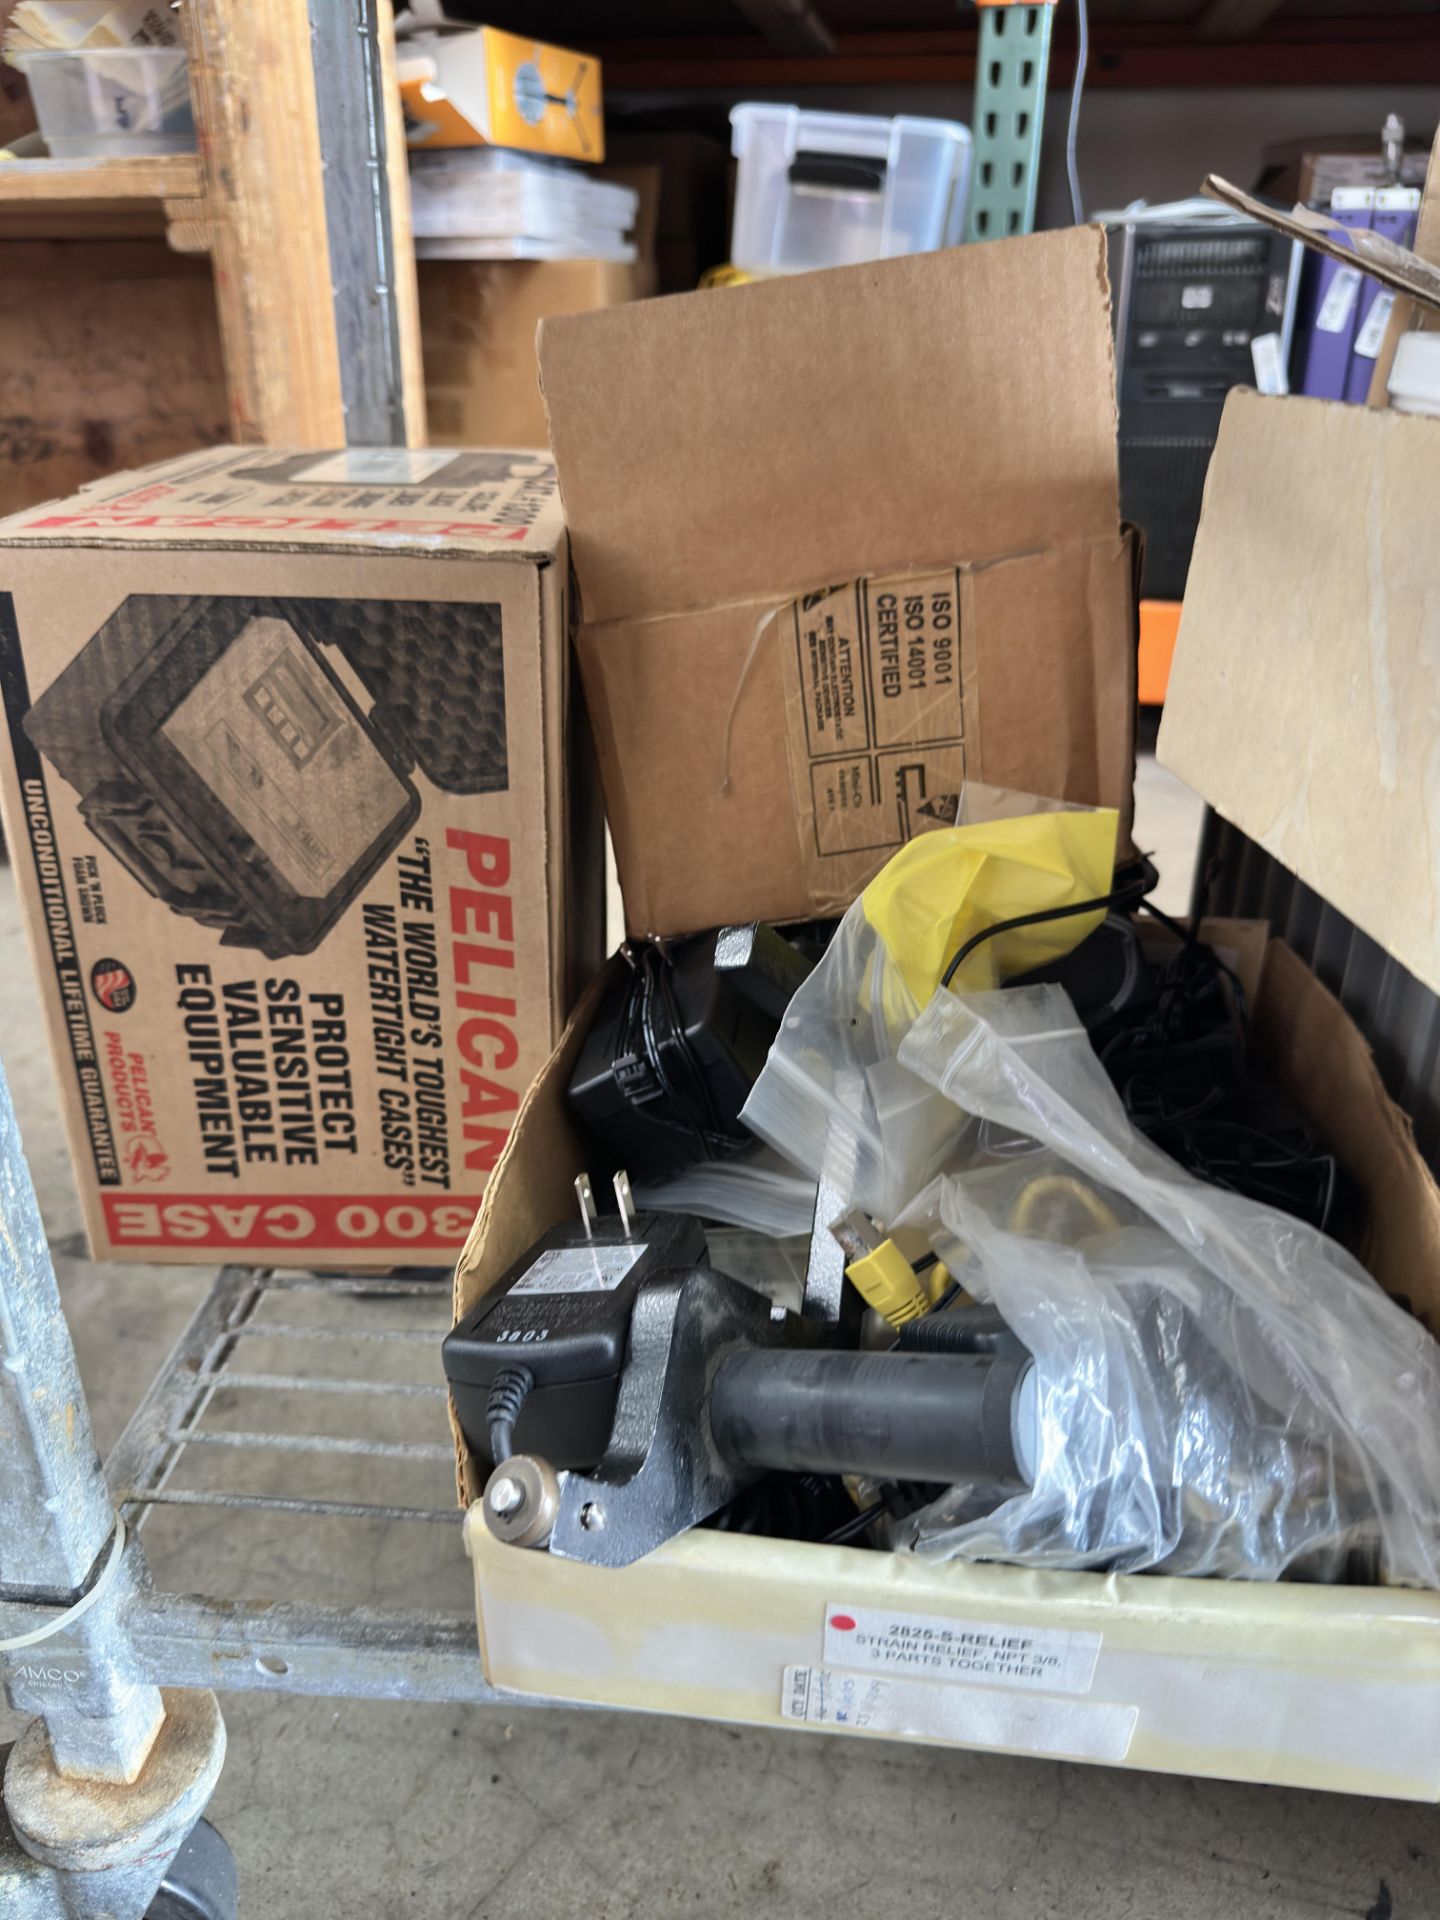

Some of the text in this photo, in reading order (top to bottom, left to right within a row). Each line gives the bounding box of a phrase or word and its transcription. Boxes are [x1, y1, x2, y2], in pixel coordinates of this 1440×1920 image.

[838, 638, 855, 717] ATTENTION
[876, 593, 902, 699] CERTIFIED
[904, 595, 927, 690] ISO 14001
[931, 591, 953, 686] ISO 9001
[23, 778, 118, 1181] UNCONDITIONAL LIFETIME GUARANTEE
[362, 903, 408, 1083] WATERTIGHT
[402, 922, 443, 1050] WORLD'S
[446, 827, 521, 1173] PELICAN
[104, 1030, 137, 1134] PRODUCTS
[175, 963, 240, 1178] EQUIPMENT
[222, 980, 278, 1163] VALUABLE
[264, 978, 319, 1166] SENSITIVE
[308, 993, 358, 1155] PROTECT
[412, 1057, 451, 1190] TOUGHEST
[112, 1203, 316, 1240] CASE
[14, 1665, 80, 1682] AMCO
[855, 1634, 918, 1651] STRAIN
[993, 1651, 1028, 1662] NPT
[869, 1649, 1043, 1678] 3 PARTS TOGETHER
